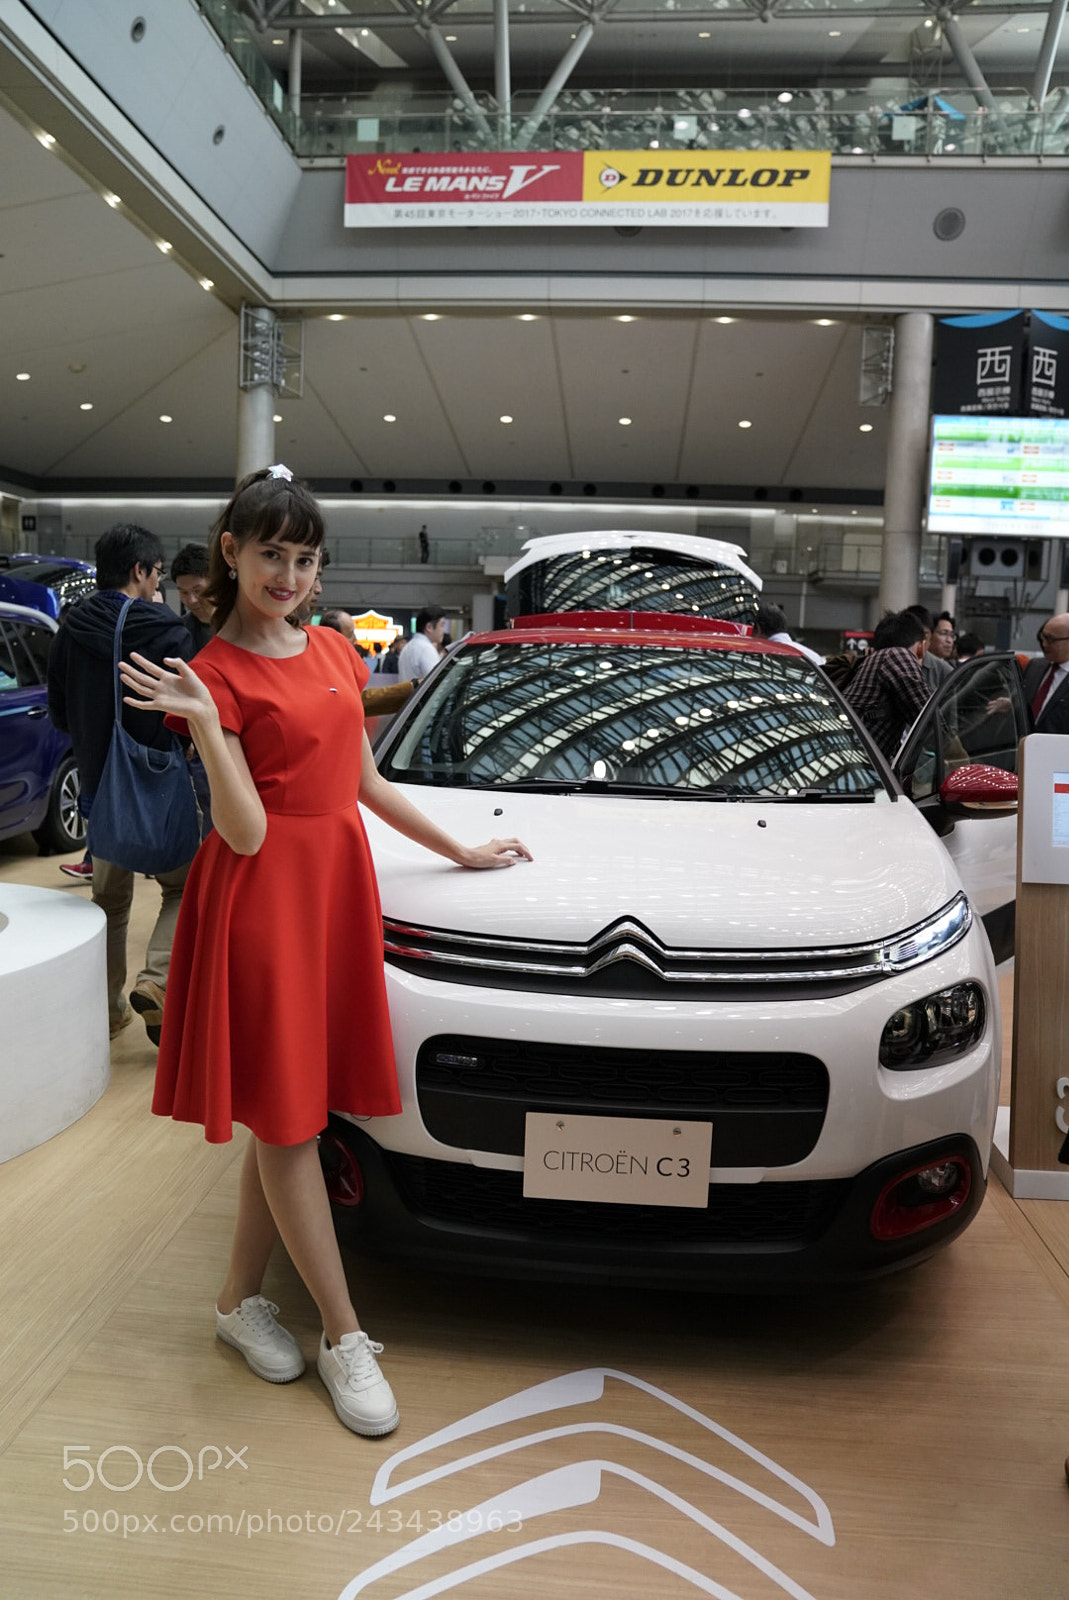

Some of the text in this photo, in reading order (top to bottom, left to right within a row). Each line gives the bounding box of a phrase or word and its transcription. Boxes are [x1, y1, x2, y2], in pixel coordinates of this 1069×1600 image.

[385, 176, 424, 192] LE
[424, 176, 506, 192] MANS
[632, 169, 810, 187] DUNLOP
[580, 208, 645, 218] CONNECTED
[647, 208, 668, 218] LAB
[976, 346, 1013, 385] 西
[1032, 346, 1058, 387] 西
[543, 1150, 690, 1177] CITROËN C3
